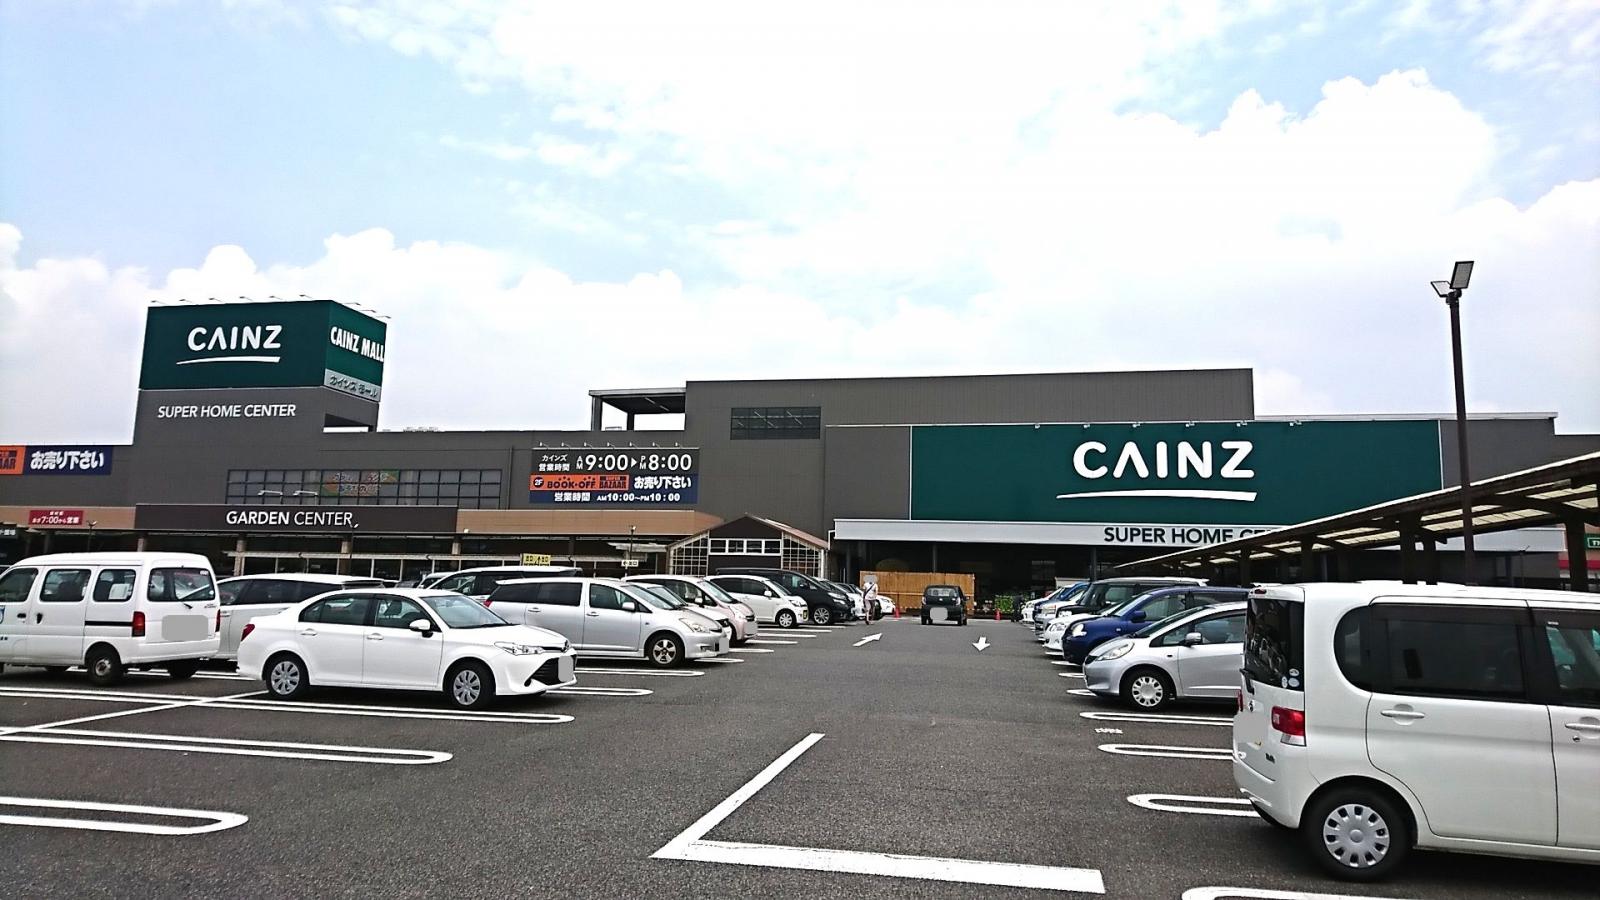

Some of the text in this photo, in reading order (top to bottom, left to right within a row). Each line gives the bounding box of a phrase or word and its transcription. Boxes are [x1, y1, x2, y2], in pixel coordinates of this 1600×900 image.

[187, 325, 283, 351] CAINZ
[330, 326, 385, 363] CAINZ MALL
[157, 404, 297, 419] SUPER HOME CENTER
[30, 450, 105, 470] お売り下さい
[541, 454, 568, 462] カインズ
[585, 454, 629, 471] 9:00
[648, 454, 692, 471] 8:00
[1072, 441, 1255, 479] CAINZ
[538, 463, 570, 472] 営業時間
[633, 475, 692, 489] お売り下さい
[554, 492, 591, 502] 営業時間
[226, 510, 352, 527] GARDEN CENTER
[1103, 526, 1166, 544] SUPER
[1171, 528, 1234, 544] HOME
